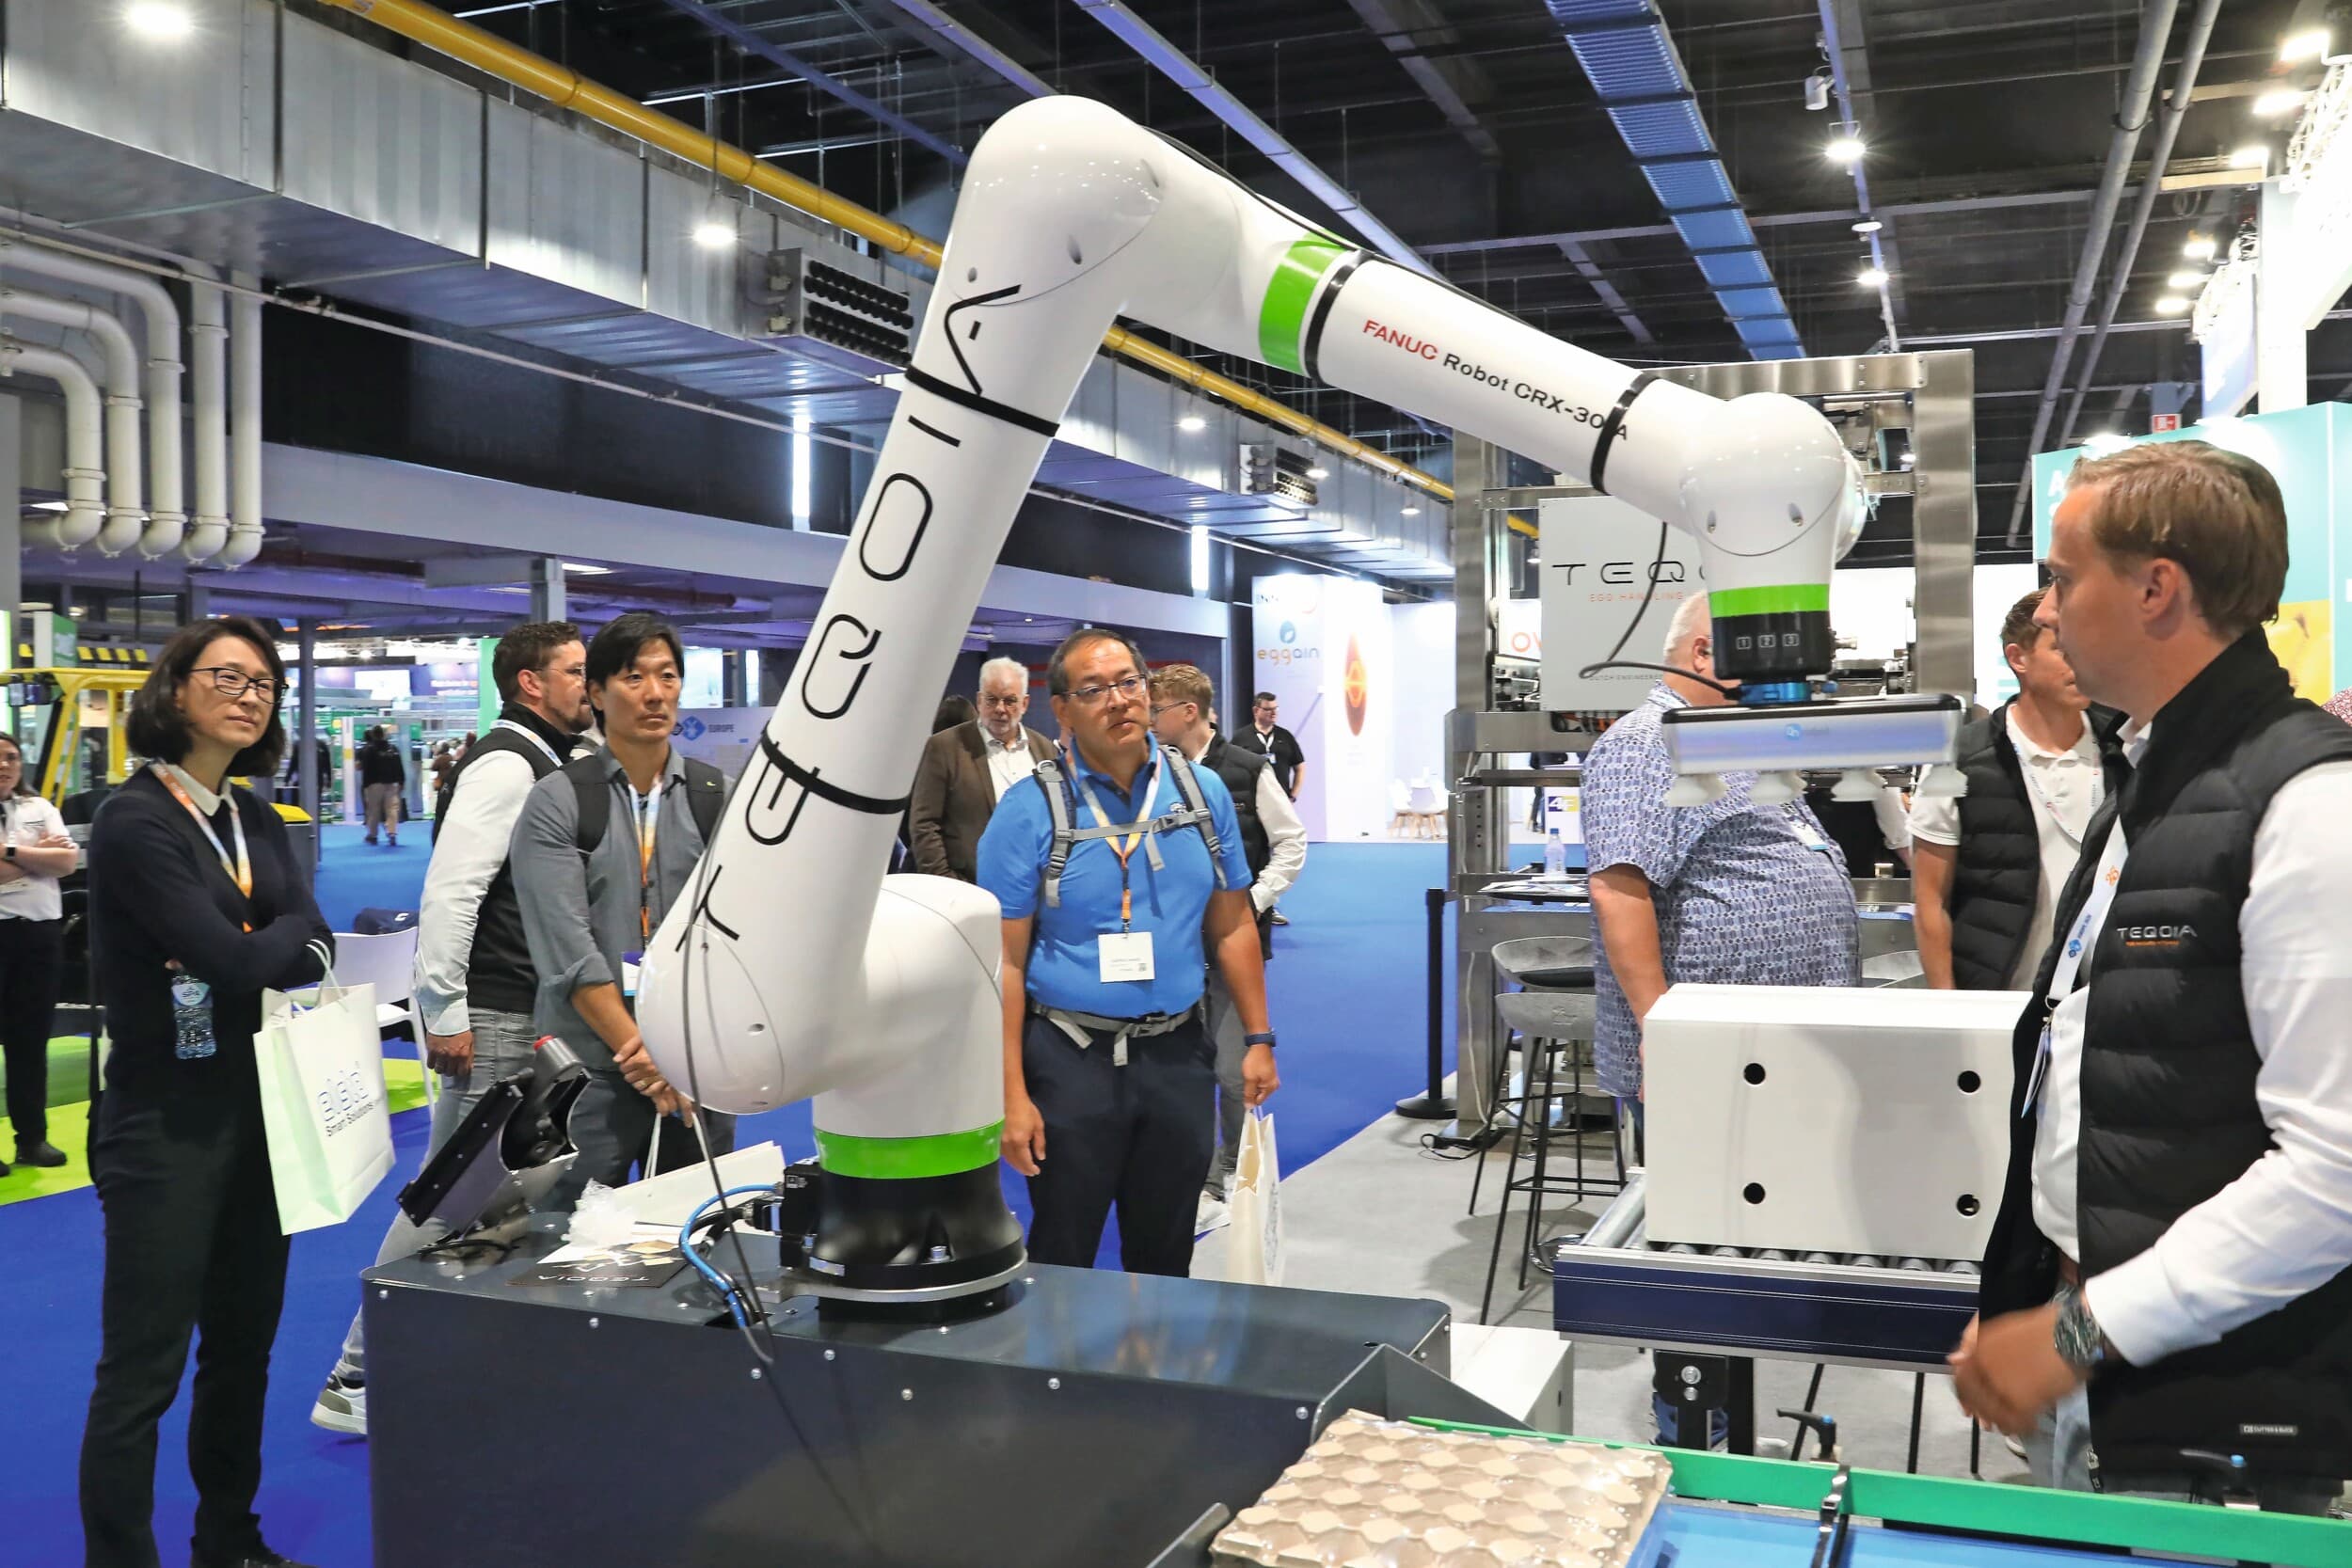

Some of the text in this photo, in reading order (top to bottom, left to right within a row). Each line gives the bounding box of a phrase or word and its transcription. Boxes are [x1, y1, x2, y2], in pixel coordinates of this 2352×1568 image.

[1363, 320, 1629, 440] FANUC Robot CRX-30A
[1551, 561, 1707, 586] TEQ
[675, 284, 1023, 953] TEQOIA
[2117, 925, 2198, 940] TEQOIA
